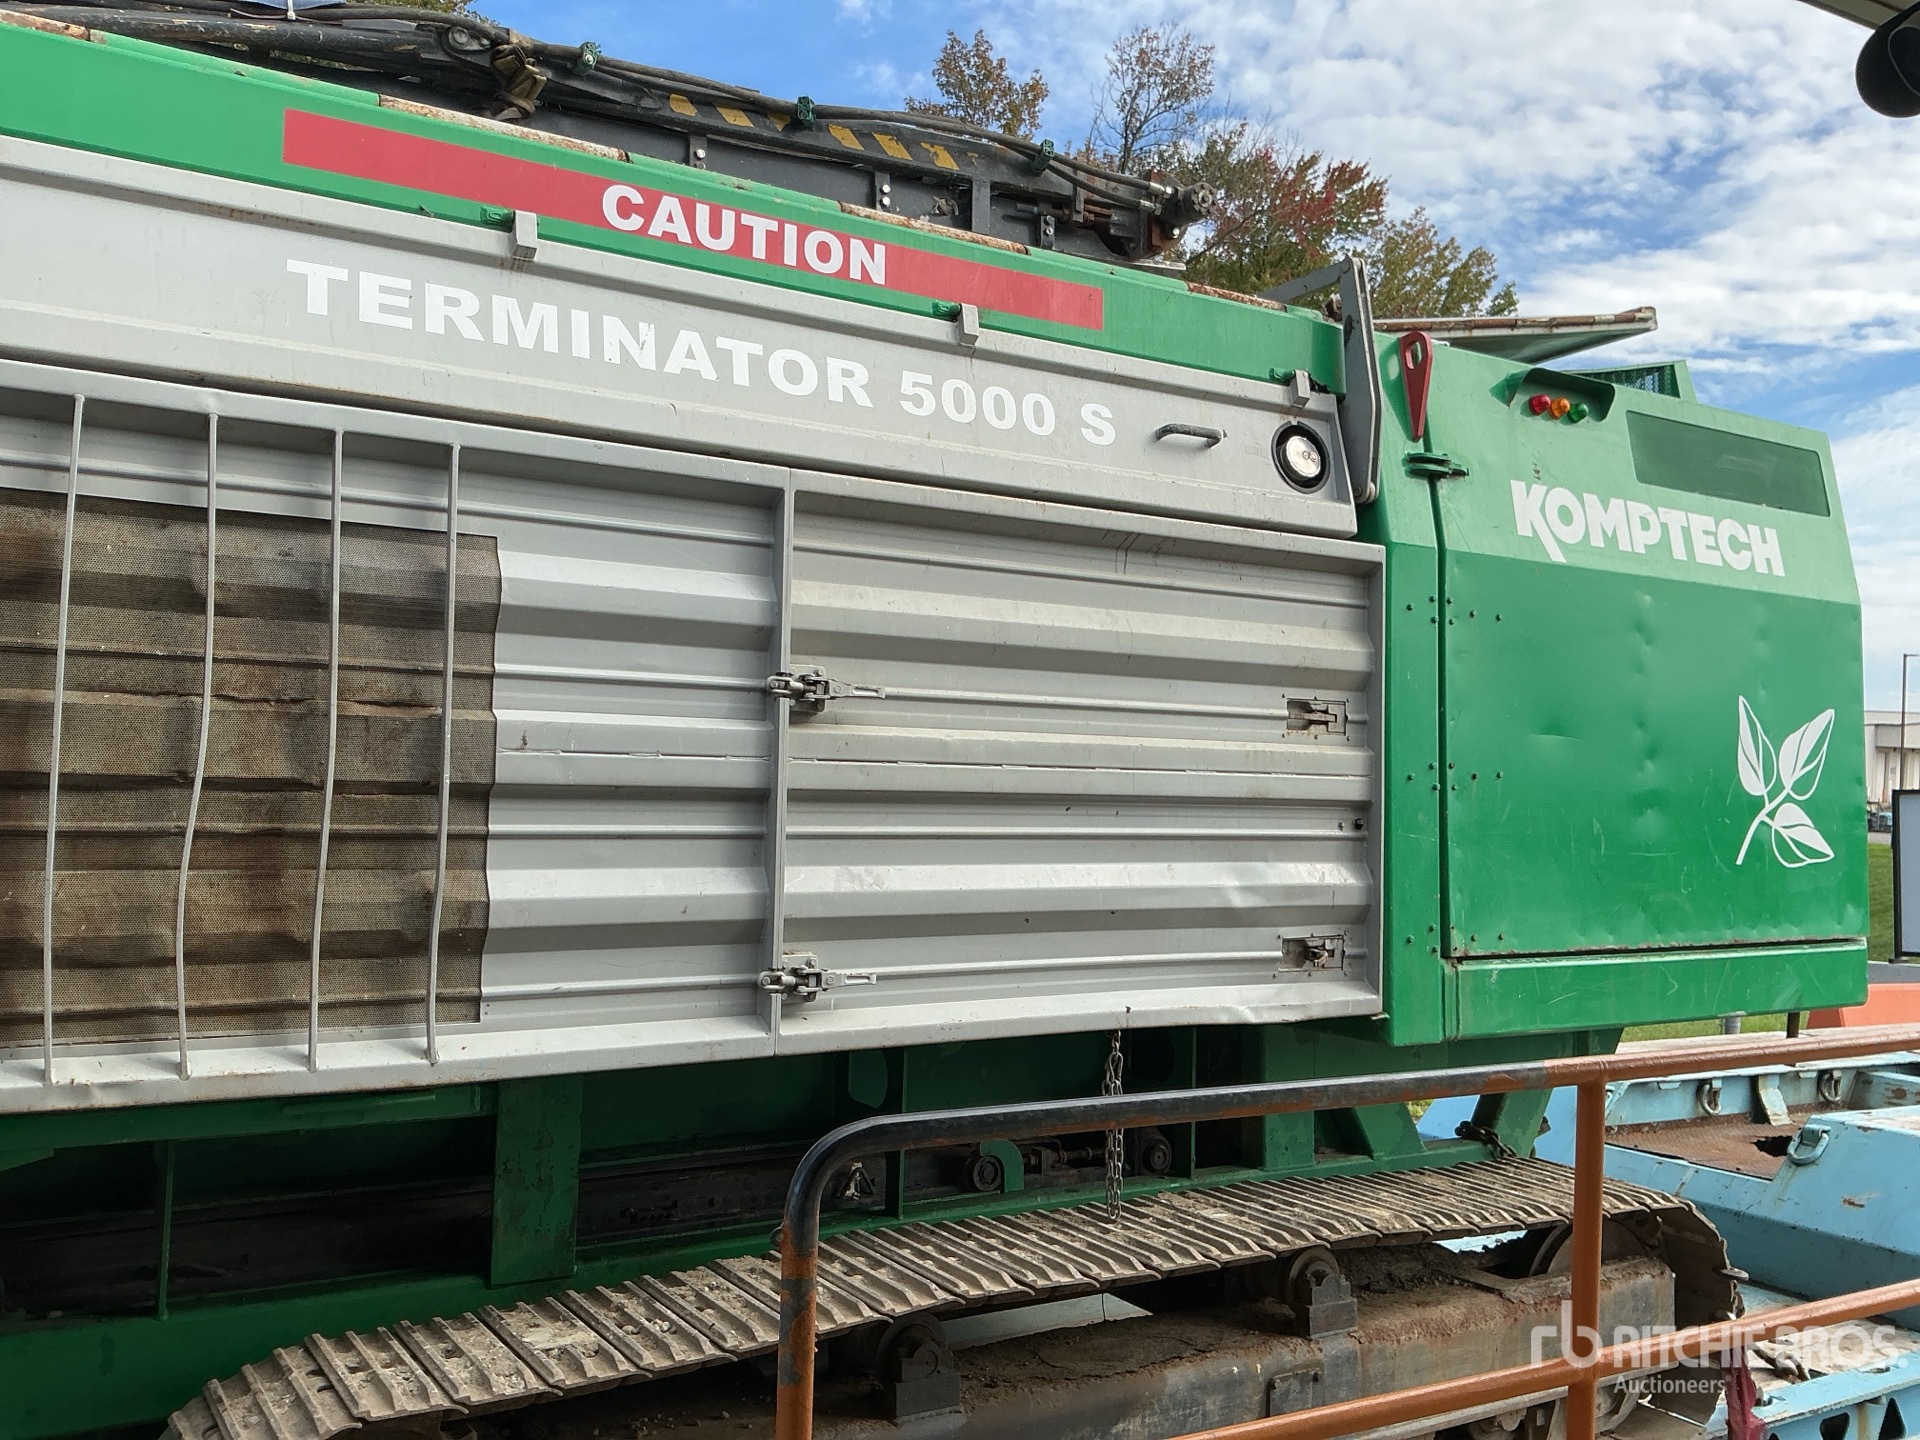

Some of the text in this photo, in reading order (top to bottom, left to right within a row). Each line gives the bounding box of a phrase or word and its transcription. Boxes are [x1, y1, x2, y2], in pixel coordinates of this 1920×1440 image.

[601, 184, 886, 286] CAUTION
[286, 259, 1116, 446] TERMINATOR 5000 S
[1511, 479, 1785, 577] KOMPTECH
